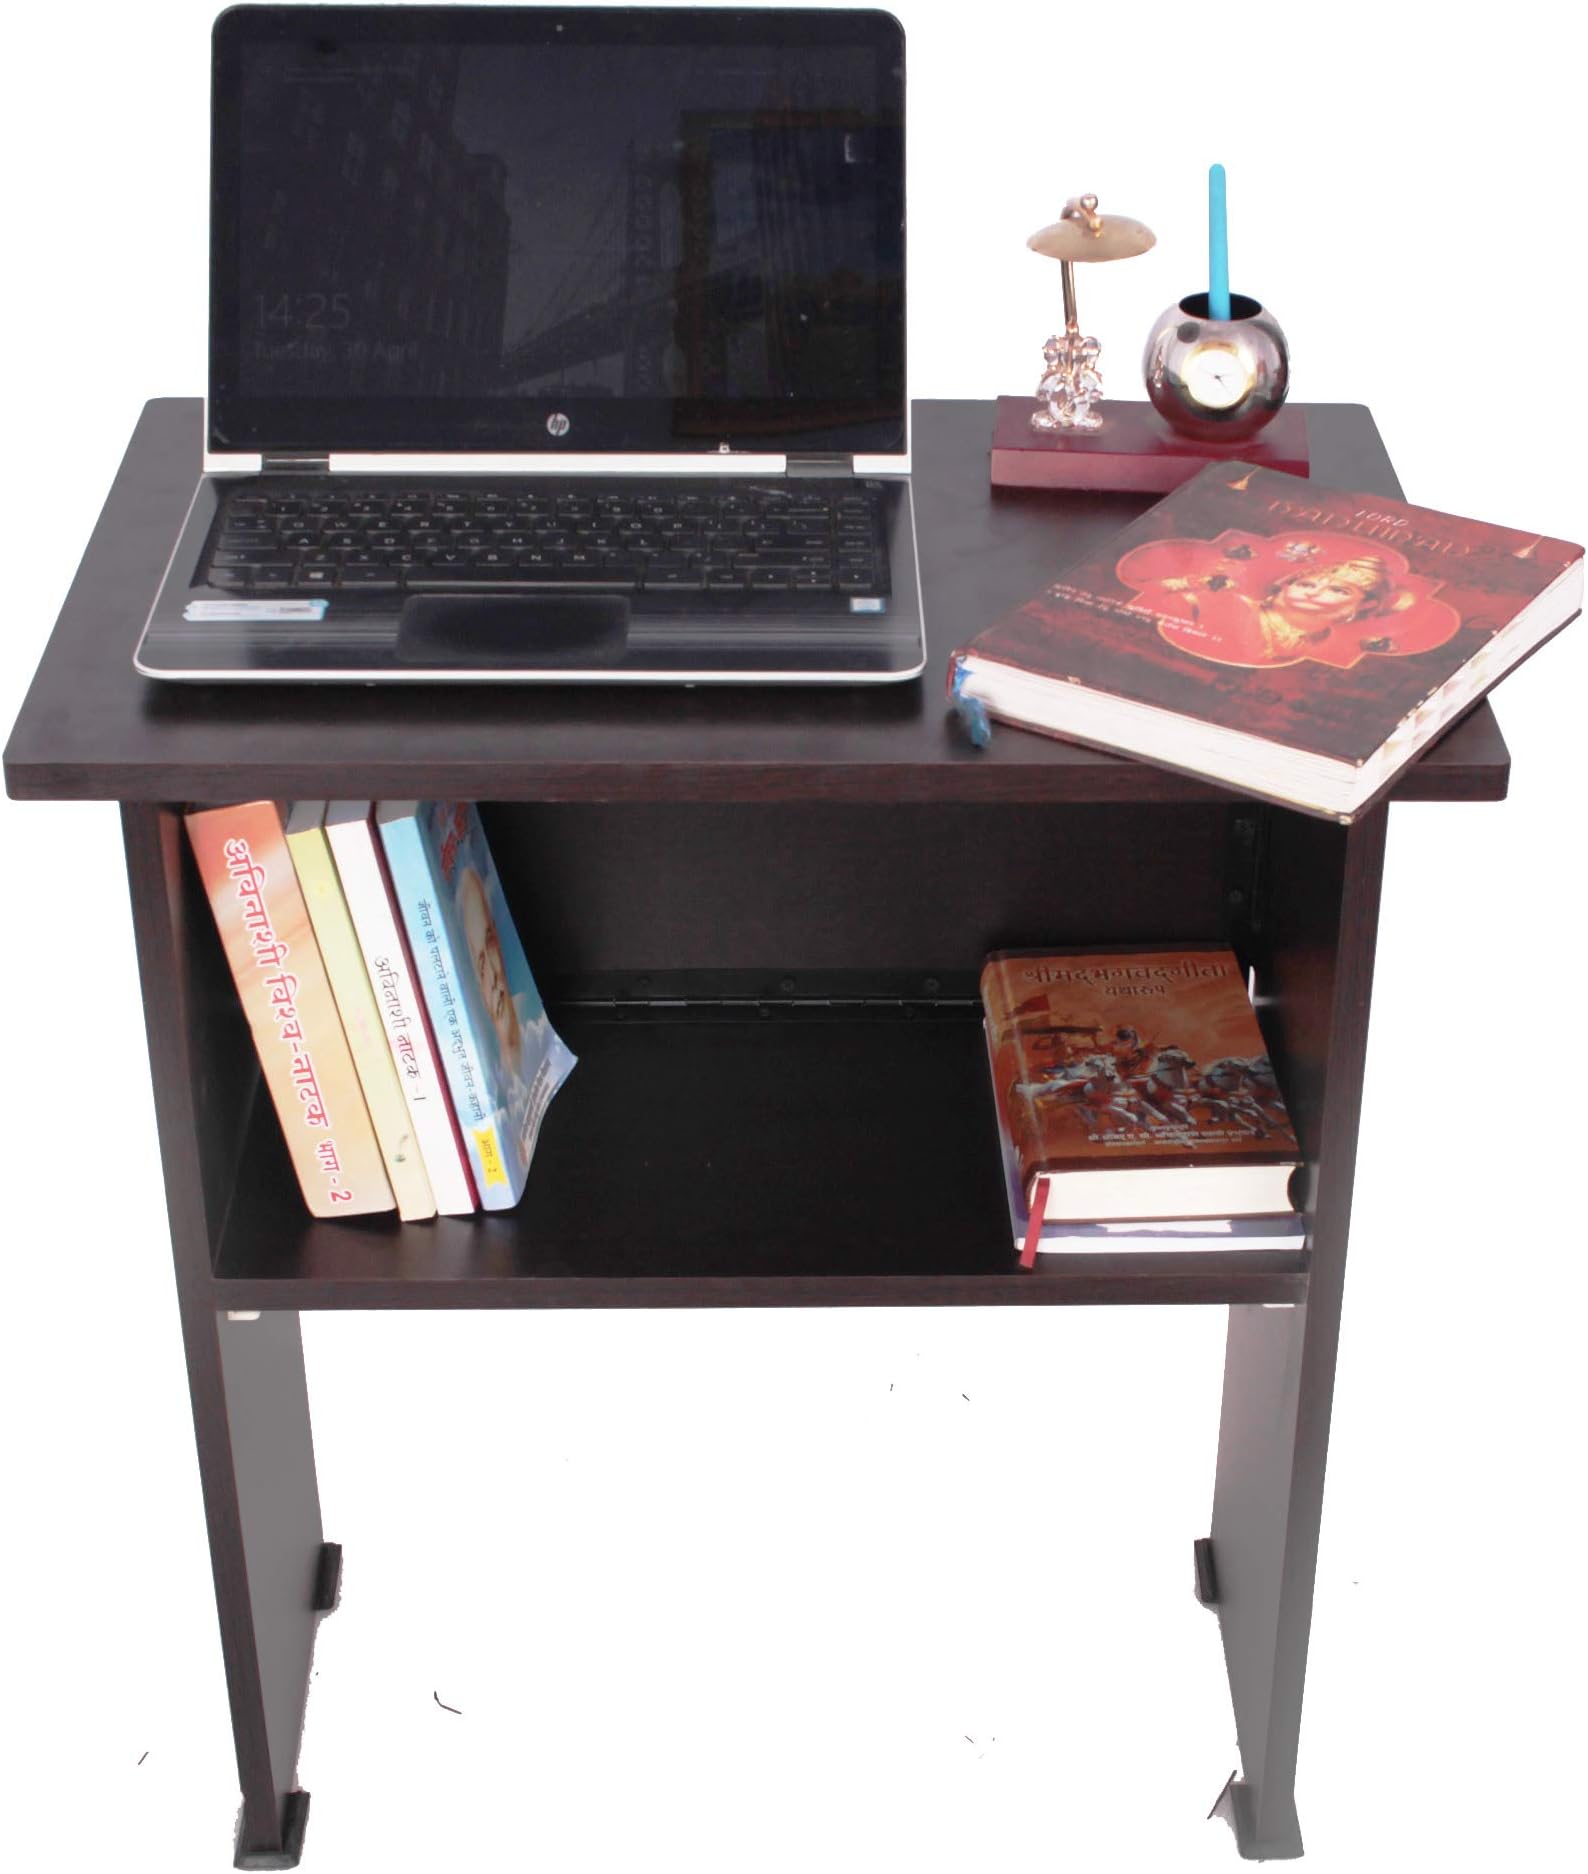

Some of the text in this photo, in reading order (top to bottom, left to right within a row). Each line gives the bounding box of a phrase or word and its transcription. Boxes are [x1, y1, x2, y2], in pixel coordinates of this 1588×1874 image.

[256, 292, 352, 329] 14:25
[546, 413, 570, 437] hp
[1354, 509, 1409, 528] LORD
[417, 898, 433, 927] जीवन
[225, 839, 289, 967] अविनाशी
[265, 973, 329, 1128] विश्व-नाटक
[317, 1139, 340, 1172] भाग
[330, 1190, 353, 1202] 2
[374, 956, 412, 1029] अविनाशी
[397, 1031, 422, 1079] नाटक
